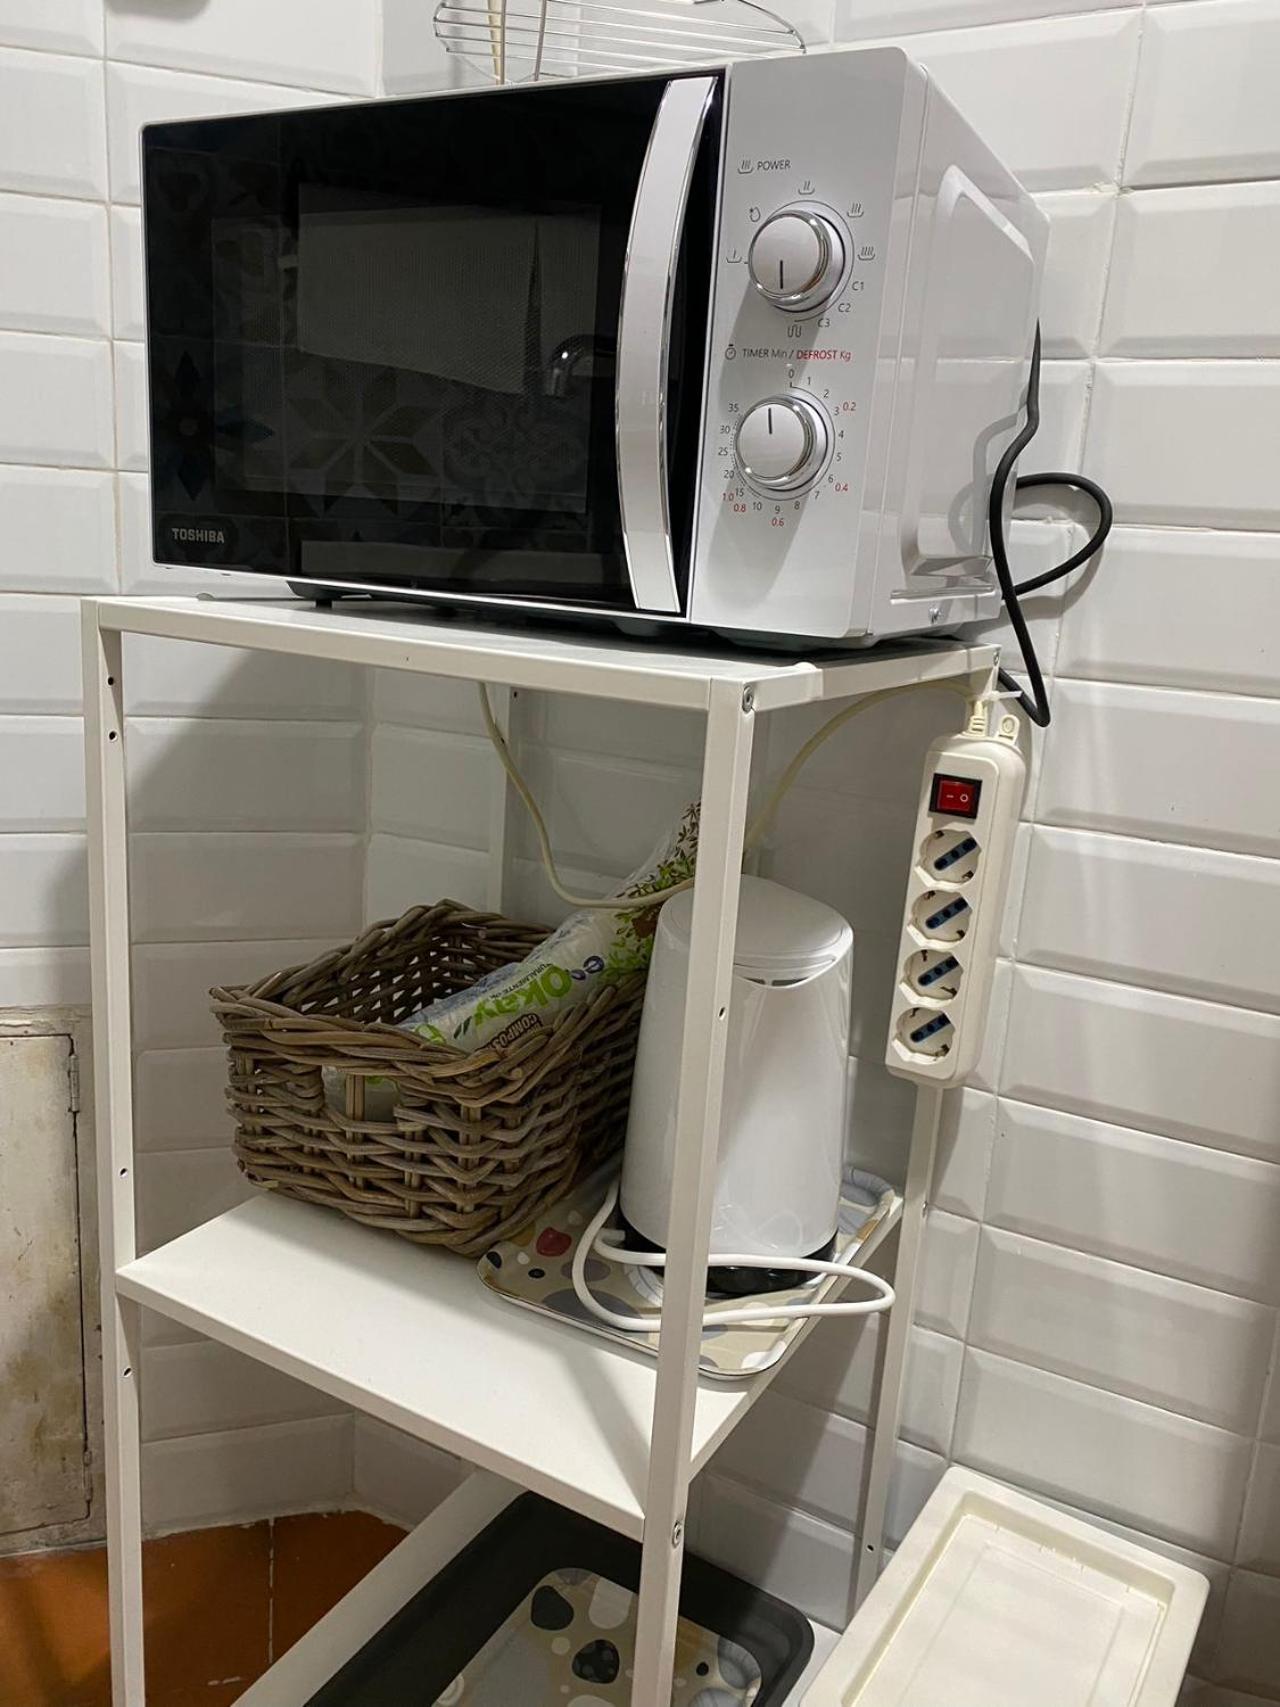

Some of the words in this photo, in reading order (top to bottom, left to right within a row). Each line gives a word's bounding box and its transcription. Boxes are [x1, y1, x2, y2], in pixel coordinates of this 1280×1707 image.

[757, 160, 791, 171] POWER
[852, 281, 864, 291] C1
[838, 303, 851, 313] C2
[817, 318, 830, 327] C3
[742, 348, 769, 358] TIMER
[796, 350, 837, 360] DEFROST
[840, 351, 851, 362] Kg
[823, 389, 830, 398] 2
[728, 404, 739, 413] 35
[842, 402, 856, 411] 0.2
[834, 407, 840, 416] 3
[720, 425, 730, 434] 30
[838, 430, 844, 439] 4
[718, 447, 728, 456] 25
[836, 453, 842, 462] 5
[724, 470, 735, 479] 20
[828, 474, 834, 483] 6
[835, 483, 848, 492] 0.4
[815, 491, 820, 499] 7
[733, 503, 746, 512] 0.8
[753, 502, 762, 511] 10
[774, 504, 780, 514] 9
[794, 501, 800, 510] 8
[771, 517, 784, 527] 0.6
[171, 528, 225, 543] TOSHIBA
